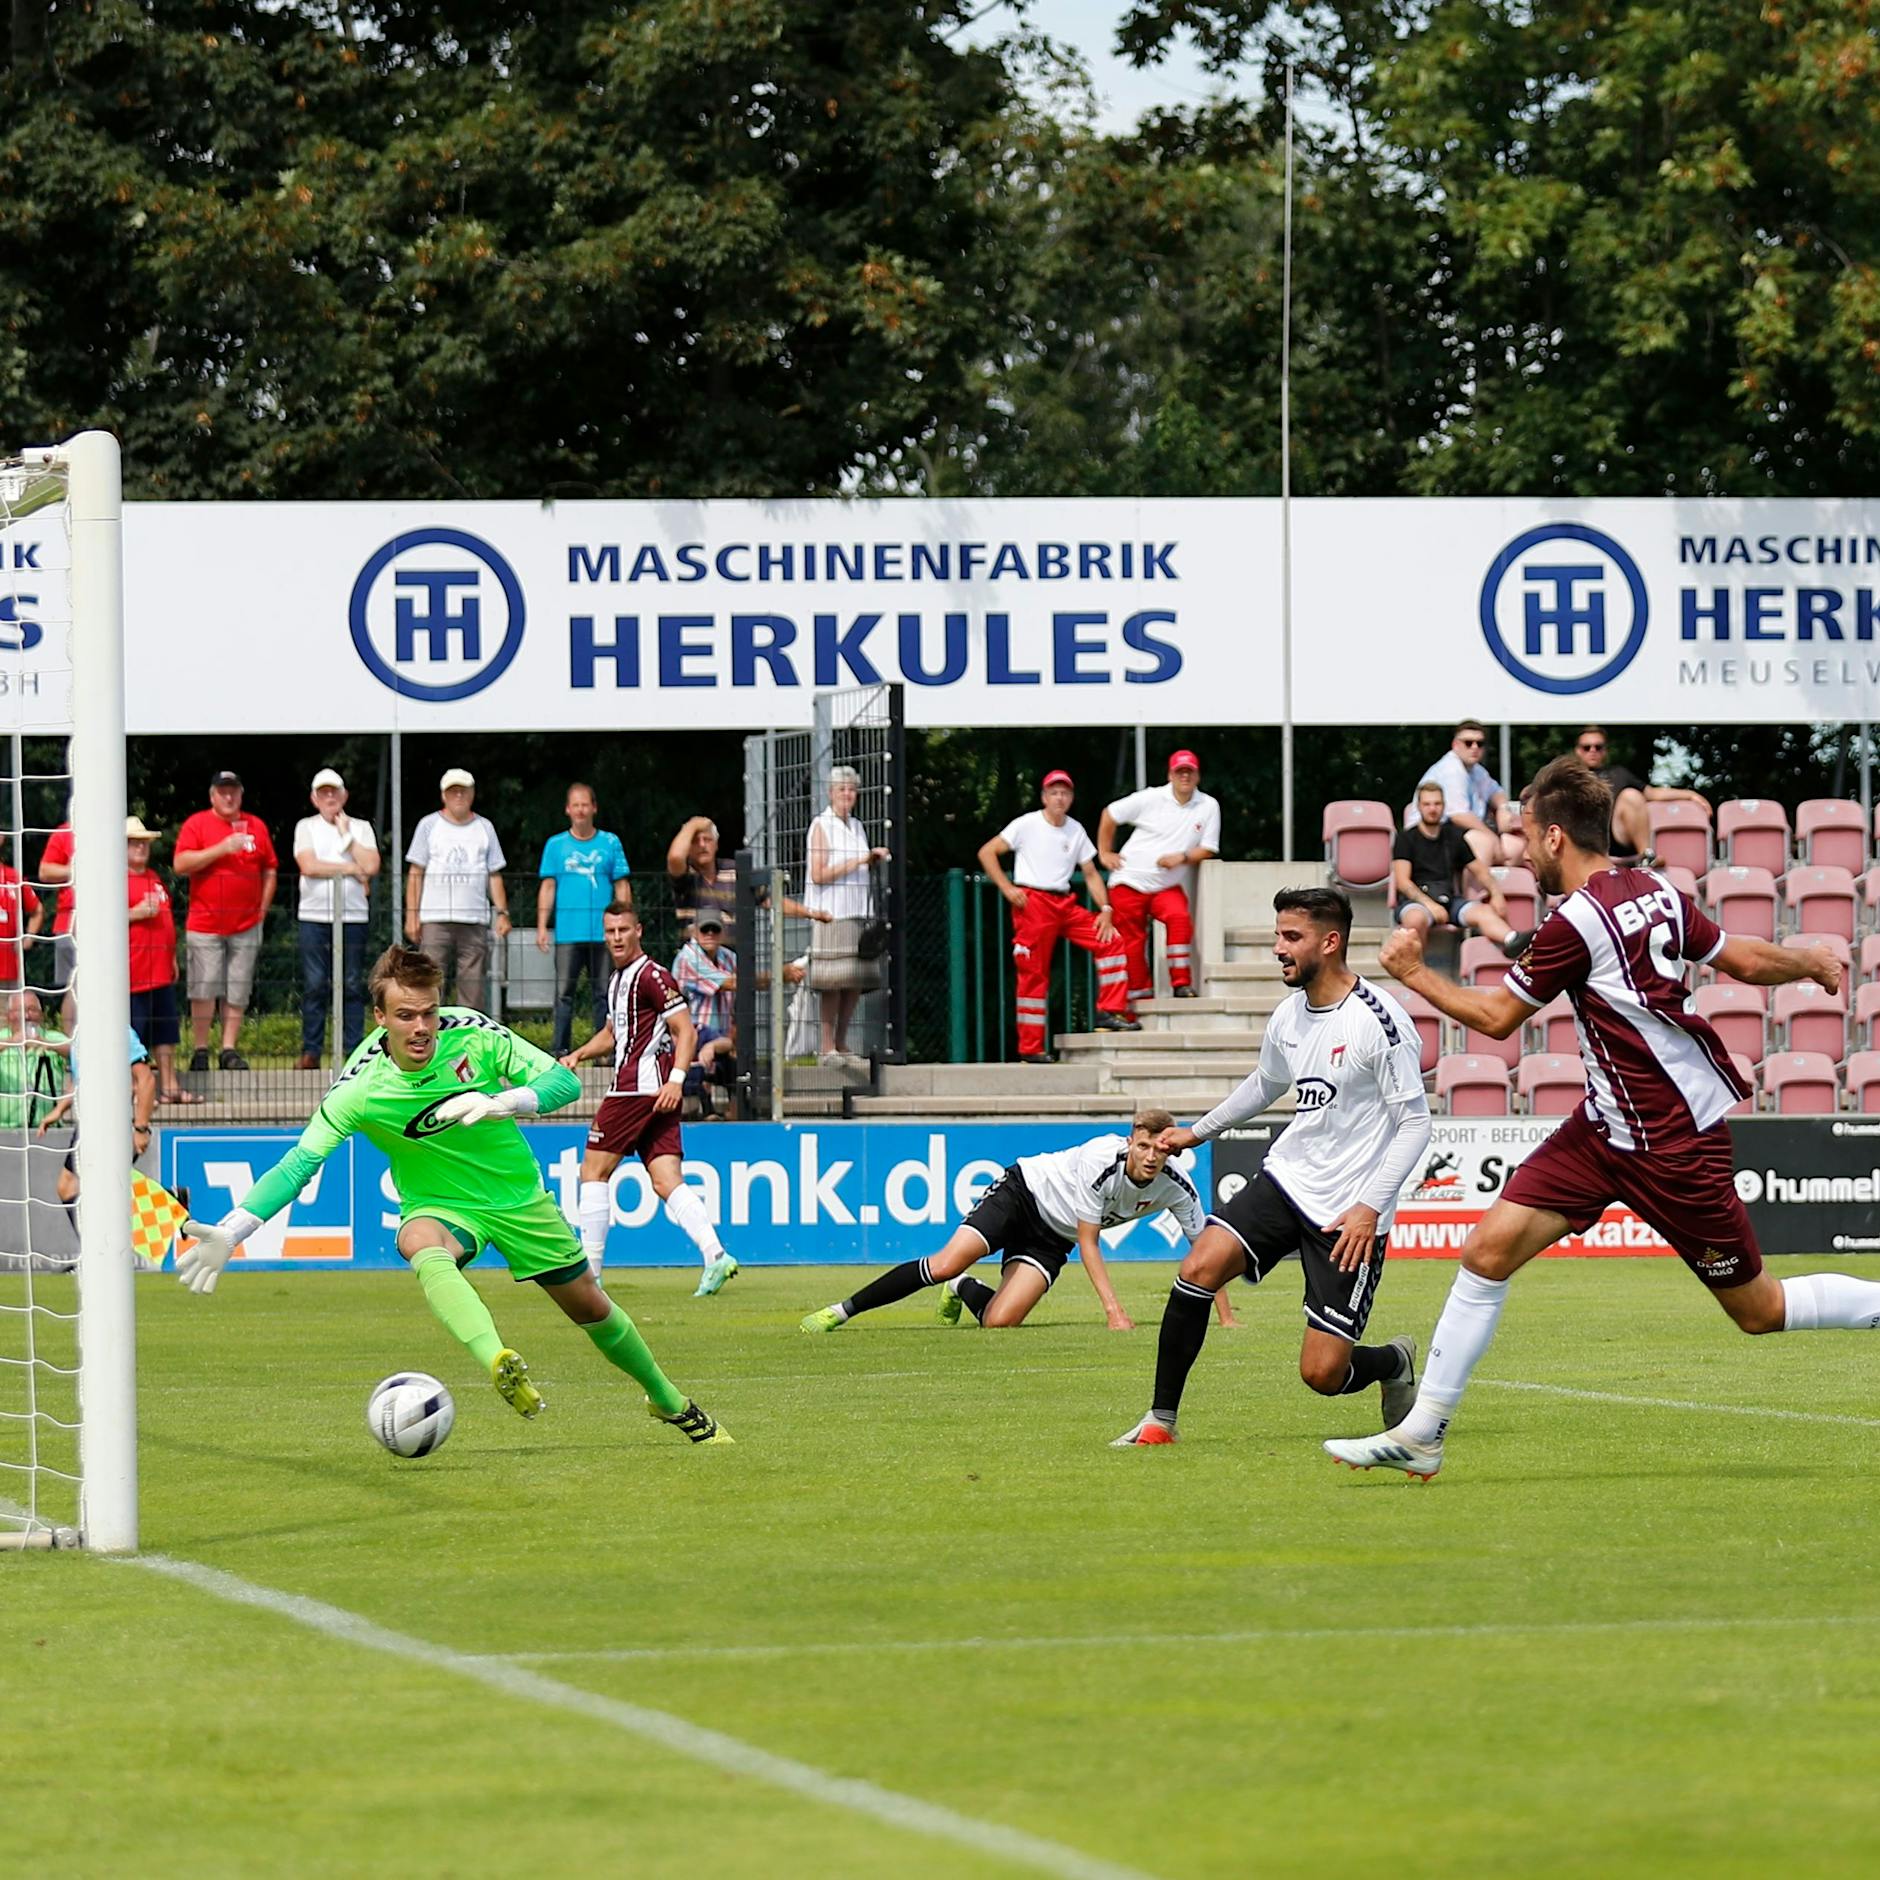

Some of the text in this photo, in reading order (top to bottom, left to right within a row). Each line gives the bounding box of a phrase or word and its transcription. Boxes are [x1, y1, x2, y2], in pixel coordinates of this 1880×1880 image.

[568, 541, 1179, 583] MASCHINENFABRIK
[569, 610, 1184, 687] HERKULES
[1429, 1127, 1553, 1143] SPORT BEFLOC
[1765, 1168, 1880, 1204] hummel
